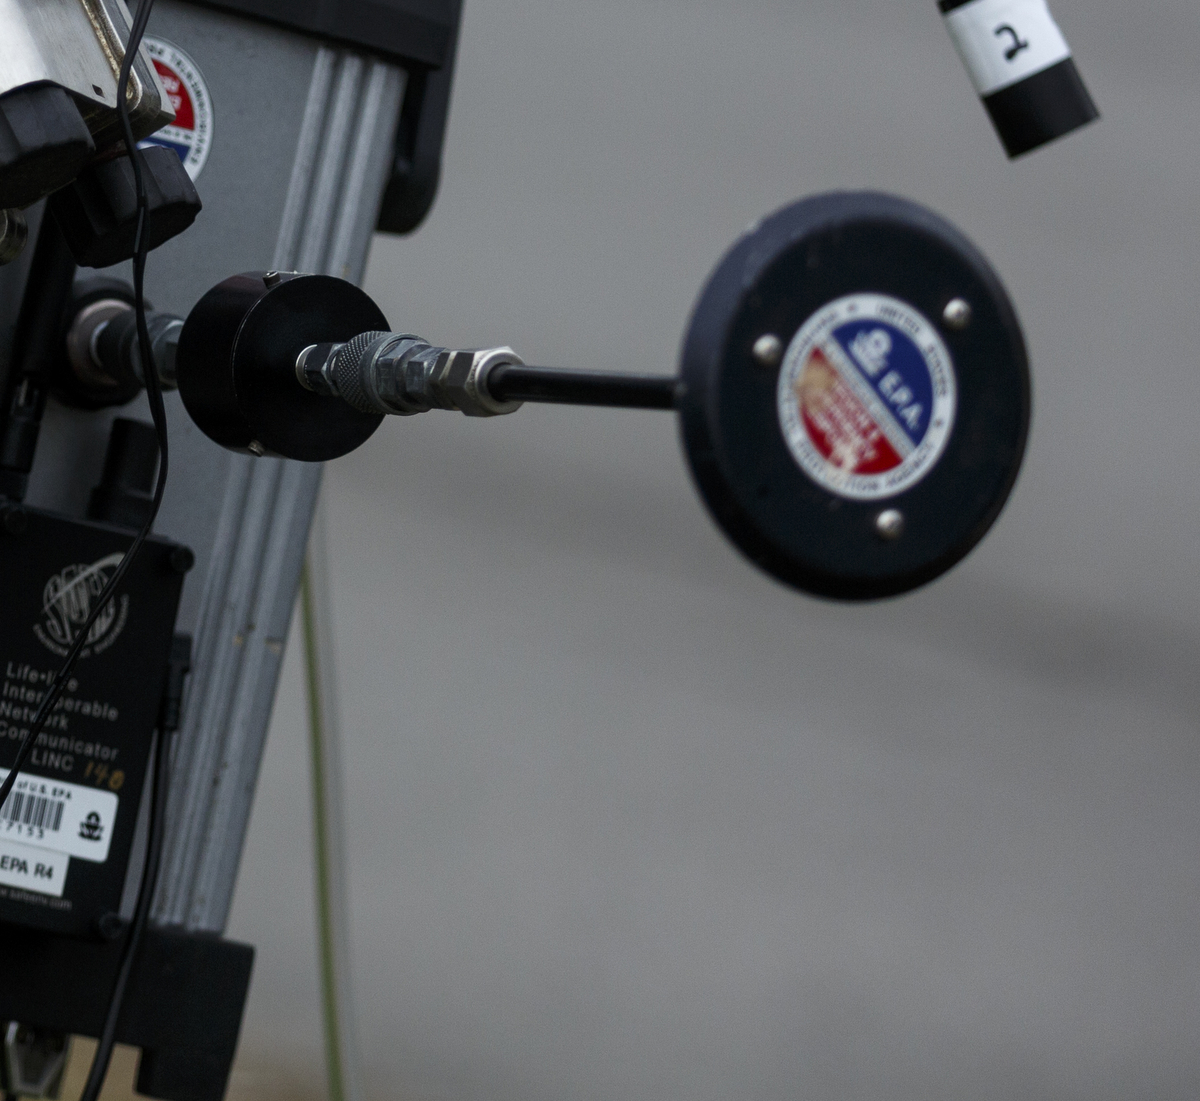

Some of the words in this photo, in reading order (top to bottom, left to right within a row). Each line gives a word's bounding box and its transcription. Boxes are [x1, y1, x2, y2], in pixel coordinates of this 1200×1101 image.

[993, 22, 1030, 63] 2
[31, 750, 75, 772] LINC
[52, 787, 72, 800] EPA
[0, 854, 28, 875] EPA
[34, 862, 54, 880] R4
